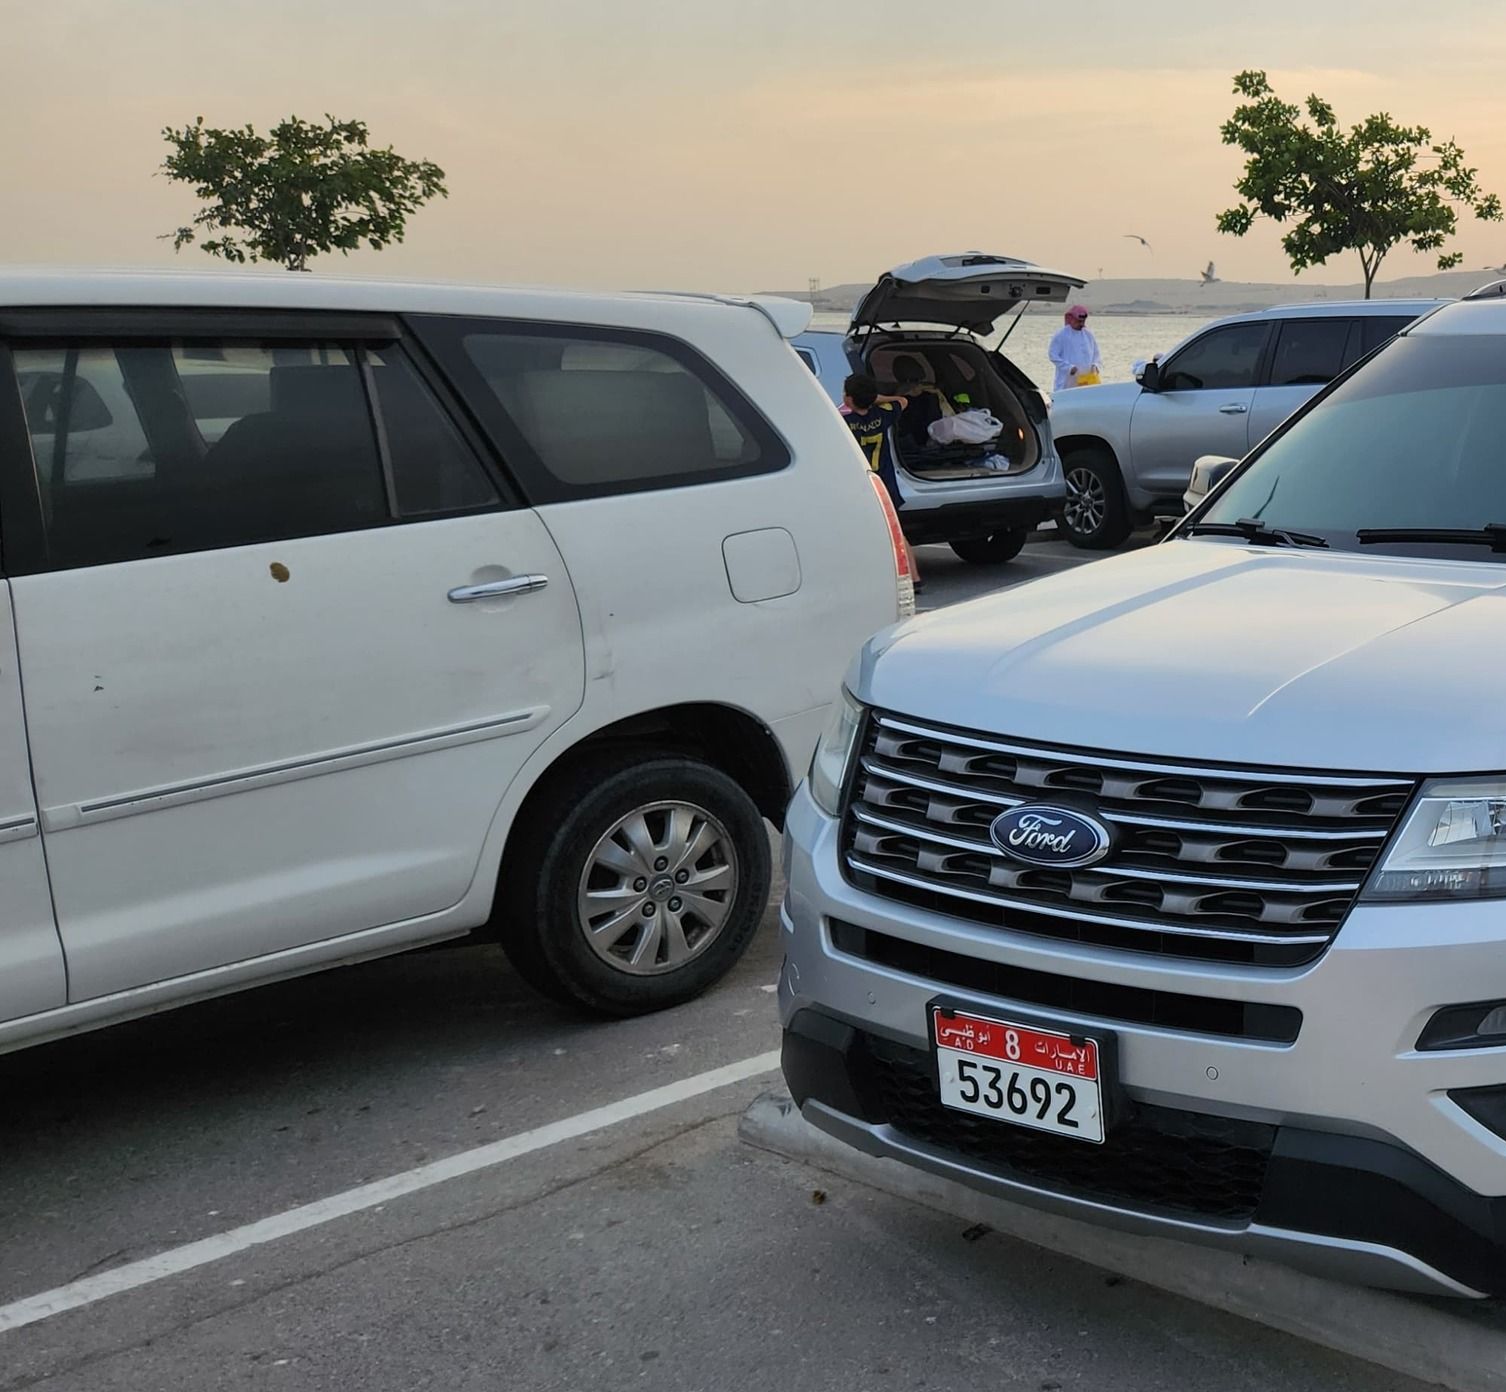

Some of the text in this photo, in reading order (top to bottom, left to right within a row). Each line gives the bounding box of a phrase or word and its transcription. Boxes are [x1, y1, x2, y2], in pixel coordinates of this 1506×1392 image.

[860, 433, 883, 472] 7
[1009, 814, 1076, 853] Ford
[1005, 1030, 1021, 1060] 8
[957, 1059, 1079, 1128] 53692
